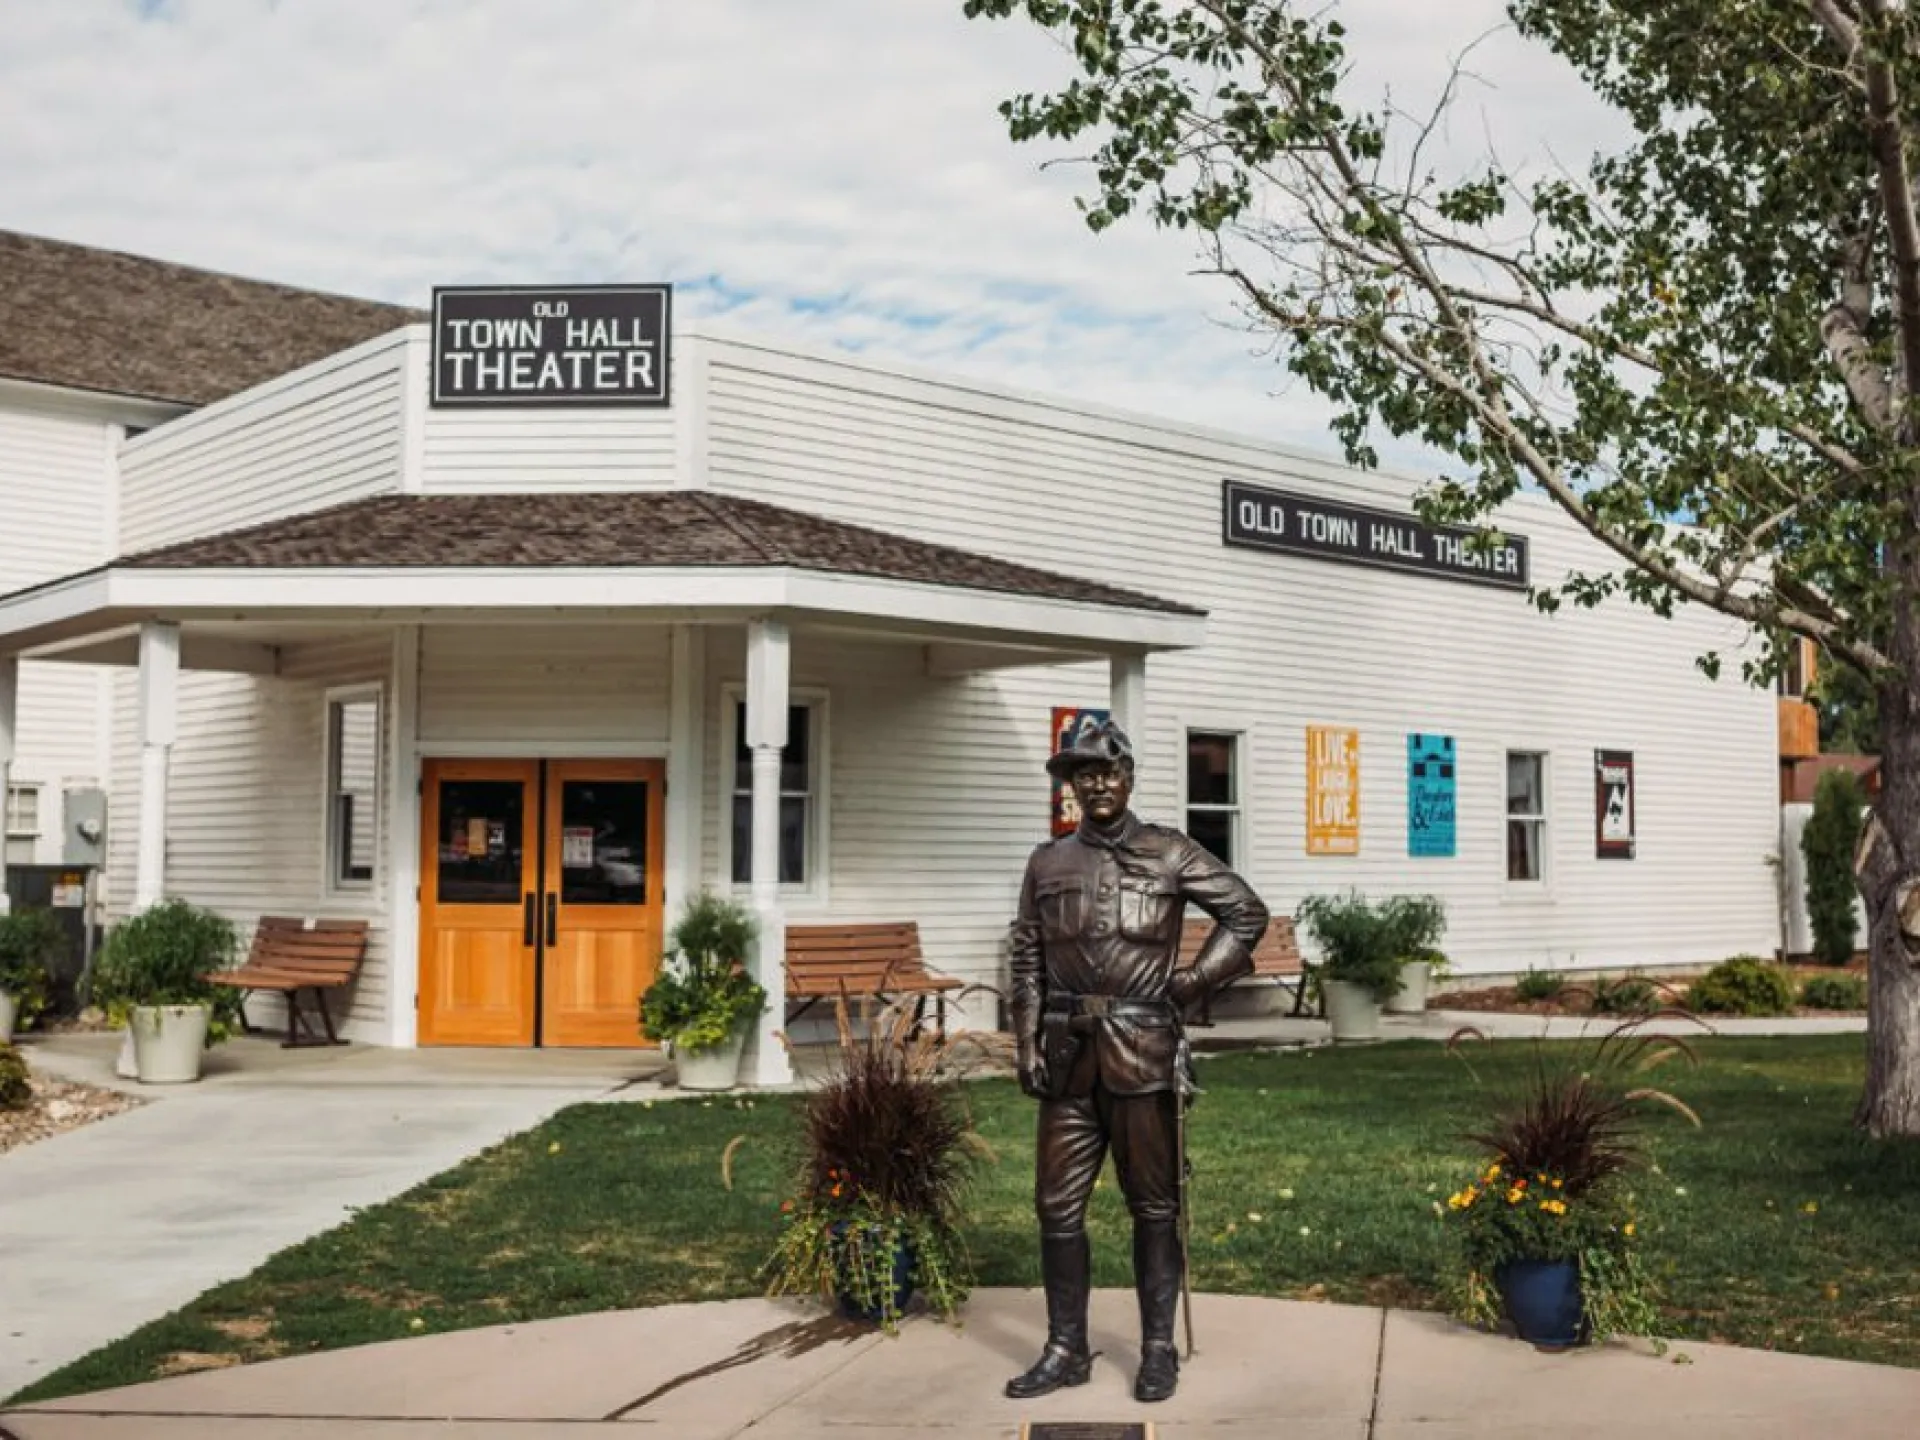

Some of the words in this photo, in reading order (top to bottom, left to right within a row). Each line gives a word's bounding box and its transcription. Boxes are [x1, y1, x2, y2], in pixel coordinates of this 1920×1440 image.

[532, 301, 569, 318] OLD
[446, 318, 543, 349] TOWN
[565, 317, 655, 348] HALL
[444, 351, 655, 390] THEATER
[1239, 501, 1284, 535] OLD
[1297, 510, 1358, 547] TOWN
[1370, 523, 1424, 558] HALL
